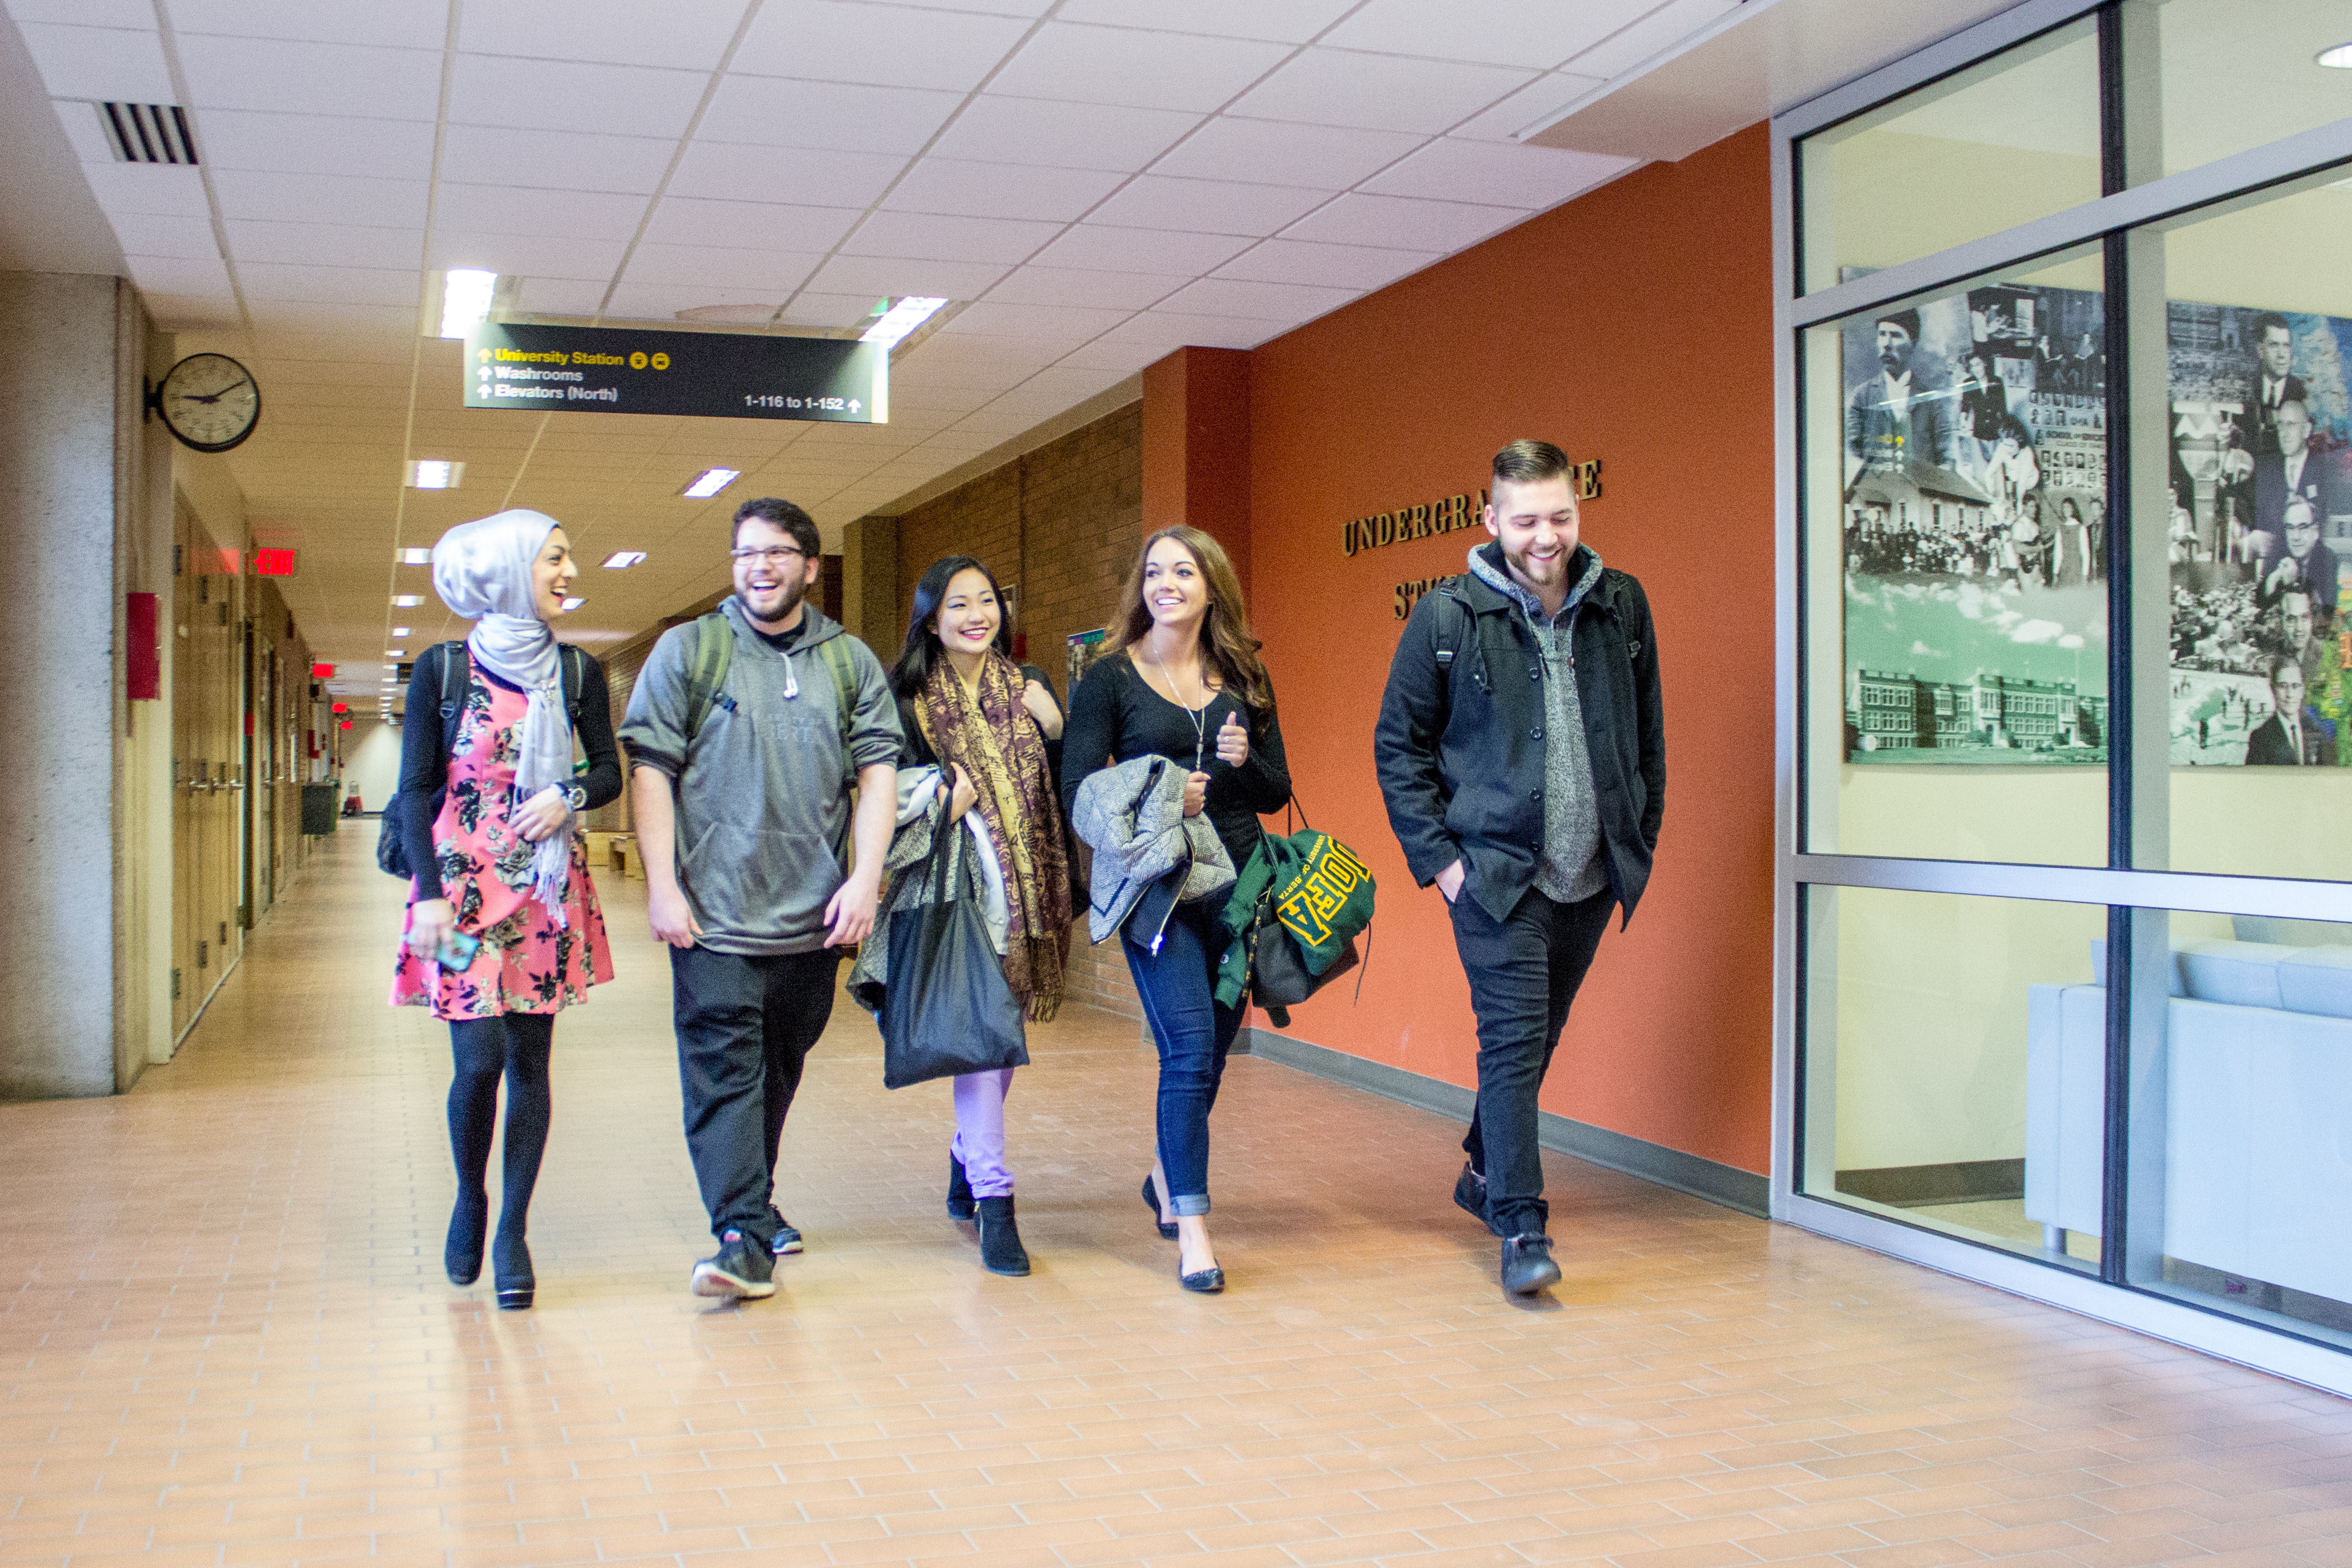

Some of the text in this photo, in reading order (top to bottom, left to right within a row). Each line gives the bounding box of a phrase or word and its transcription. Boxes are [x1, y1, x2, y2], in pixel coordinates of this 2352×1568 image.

[494, 348, 624, 365] University Station
[494, 366, 583, 382] Washrooms
[494, 384, 619, 402] Elevators (North)
[744, 394, 844, 410] 1-116 to 1-152
[1340, 459, 1600, 557] UNDERGRAE
